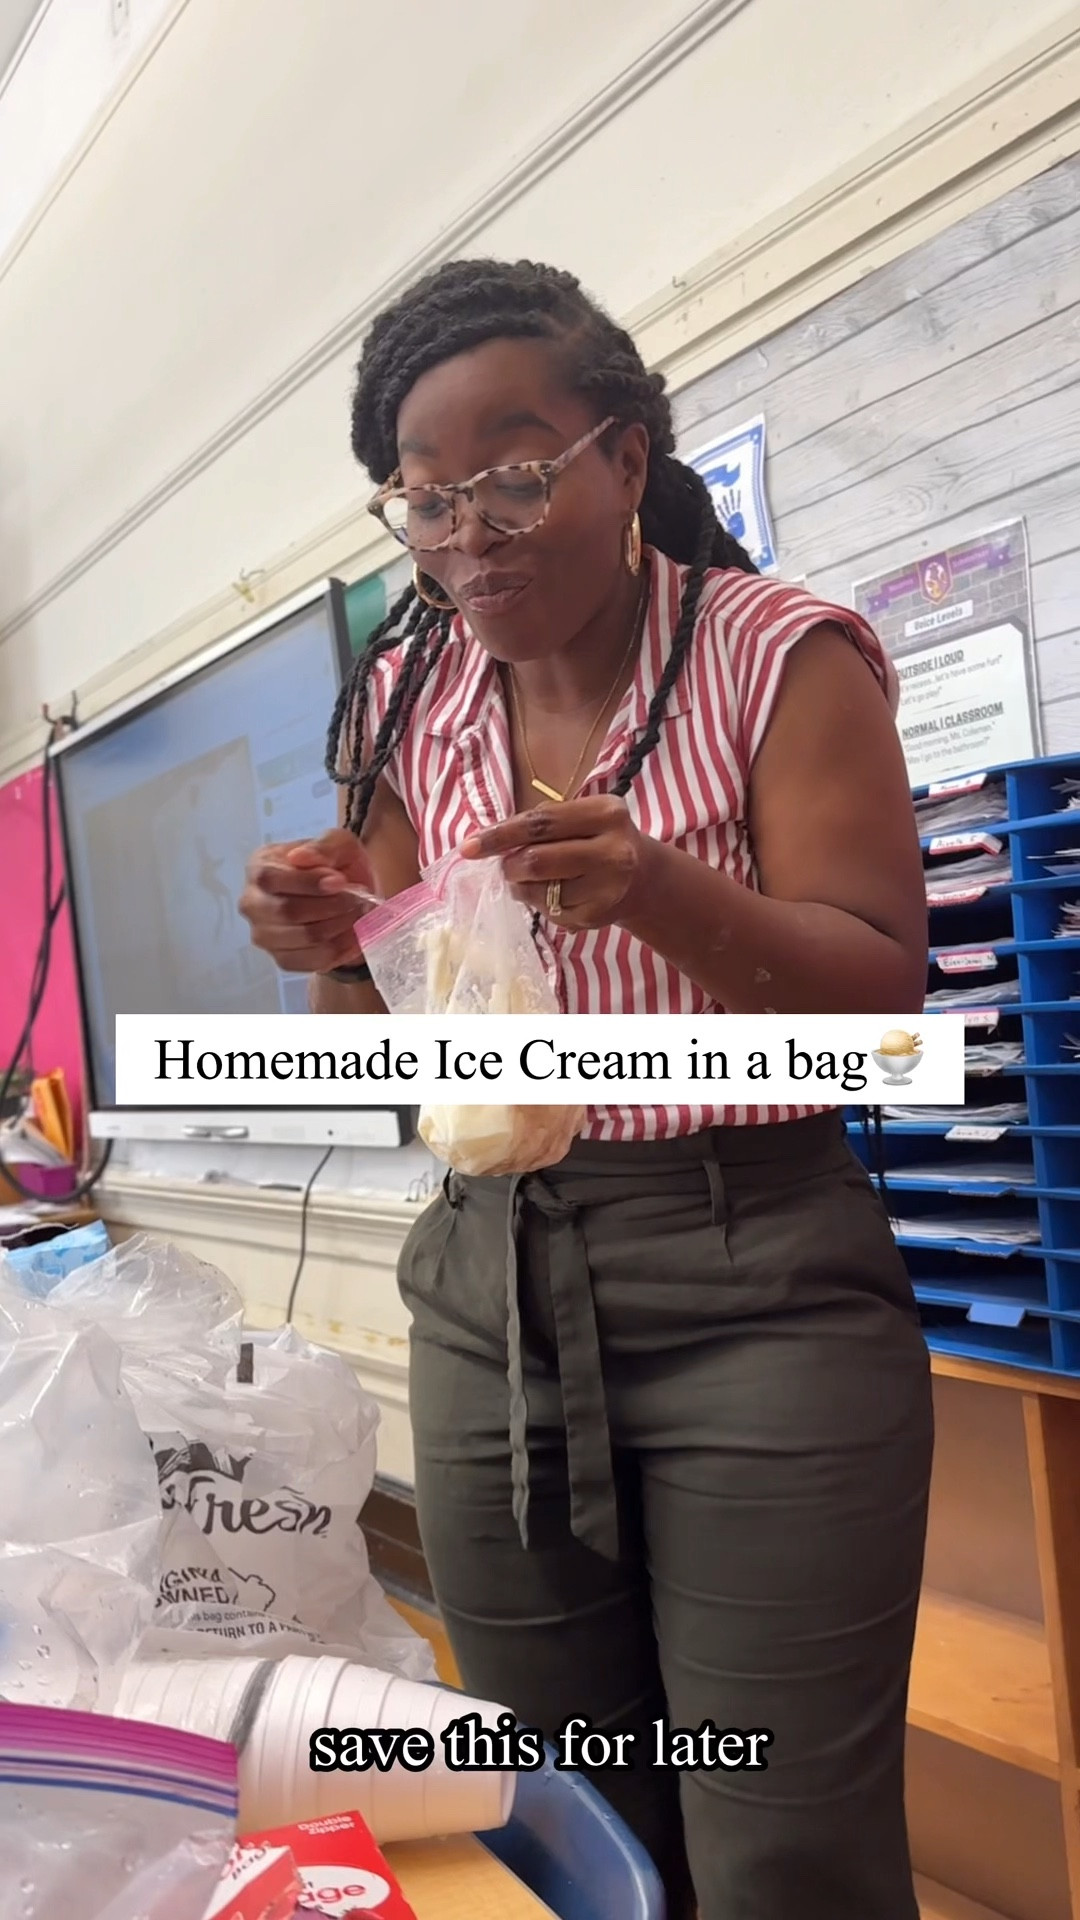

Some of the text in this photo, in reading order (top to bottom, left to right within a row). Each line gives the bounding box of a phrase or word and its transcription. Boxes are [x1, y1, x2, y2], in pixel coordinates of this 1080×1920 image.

[902, 719, 941, 740] NORMAL
[944, 701, 1004, 729] CLASSROOM
[247, 1621, 265, 1635] TO
[268, 1620, 278, 1634] A
